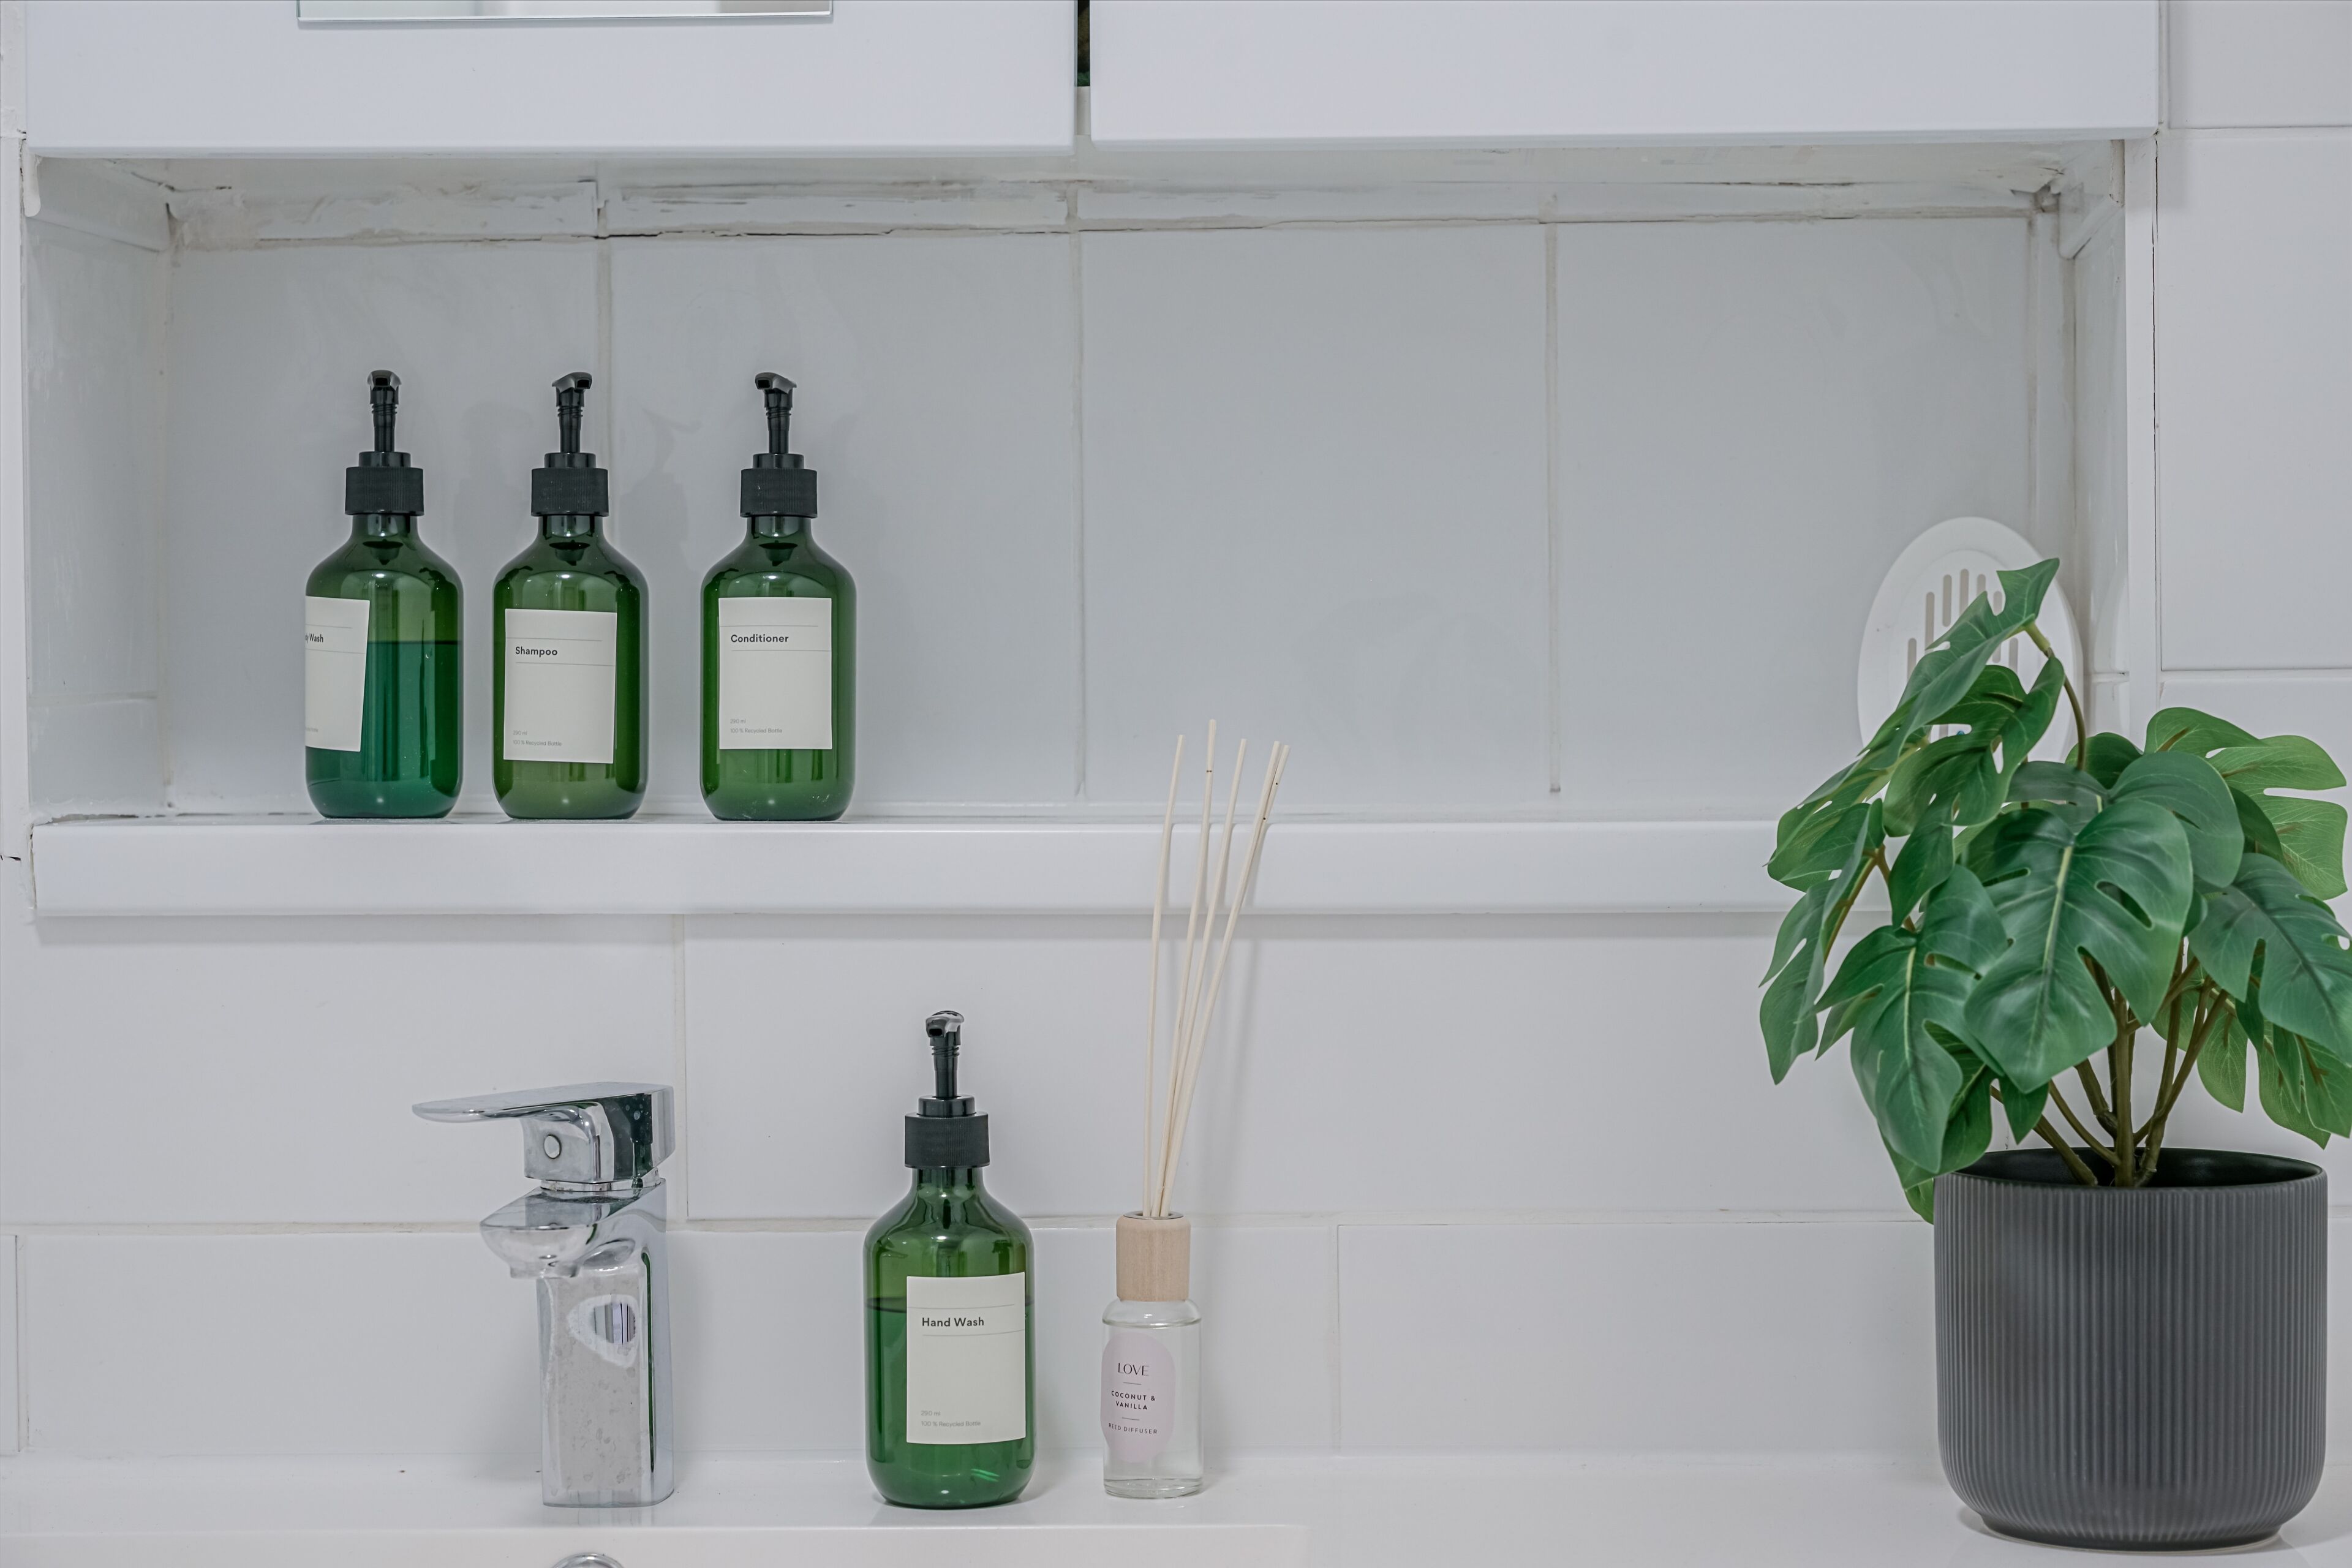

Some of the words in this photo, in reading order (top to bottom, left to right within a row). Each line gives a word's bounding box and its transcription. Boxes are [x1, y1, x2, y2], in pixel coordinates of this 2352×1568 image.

[309, 633, 323, 642] Wash
[731, 634, 789, 643] Conditioner
[515, 646, 558, 658] Shampoo
[922, 1317, 951, 1327] Hand
[954, 1316, 984, 1327] Wash
[1118, 1363, 1150, 1376] LOVE
[1111, 1390, 1147, 1400] COCONUT
[1115, 1401, 1148, 1410] VANILLA
[1109, 1422, 1121, 1431] REED
